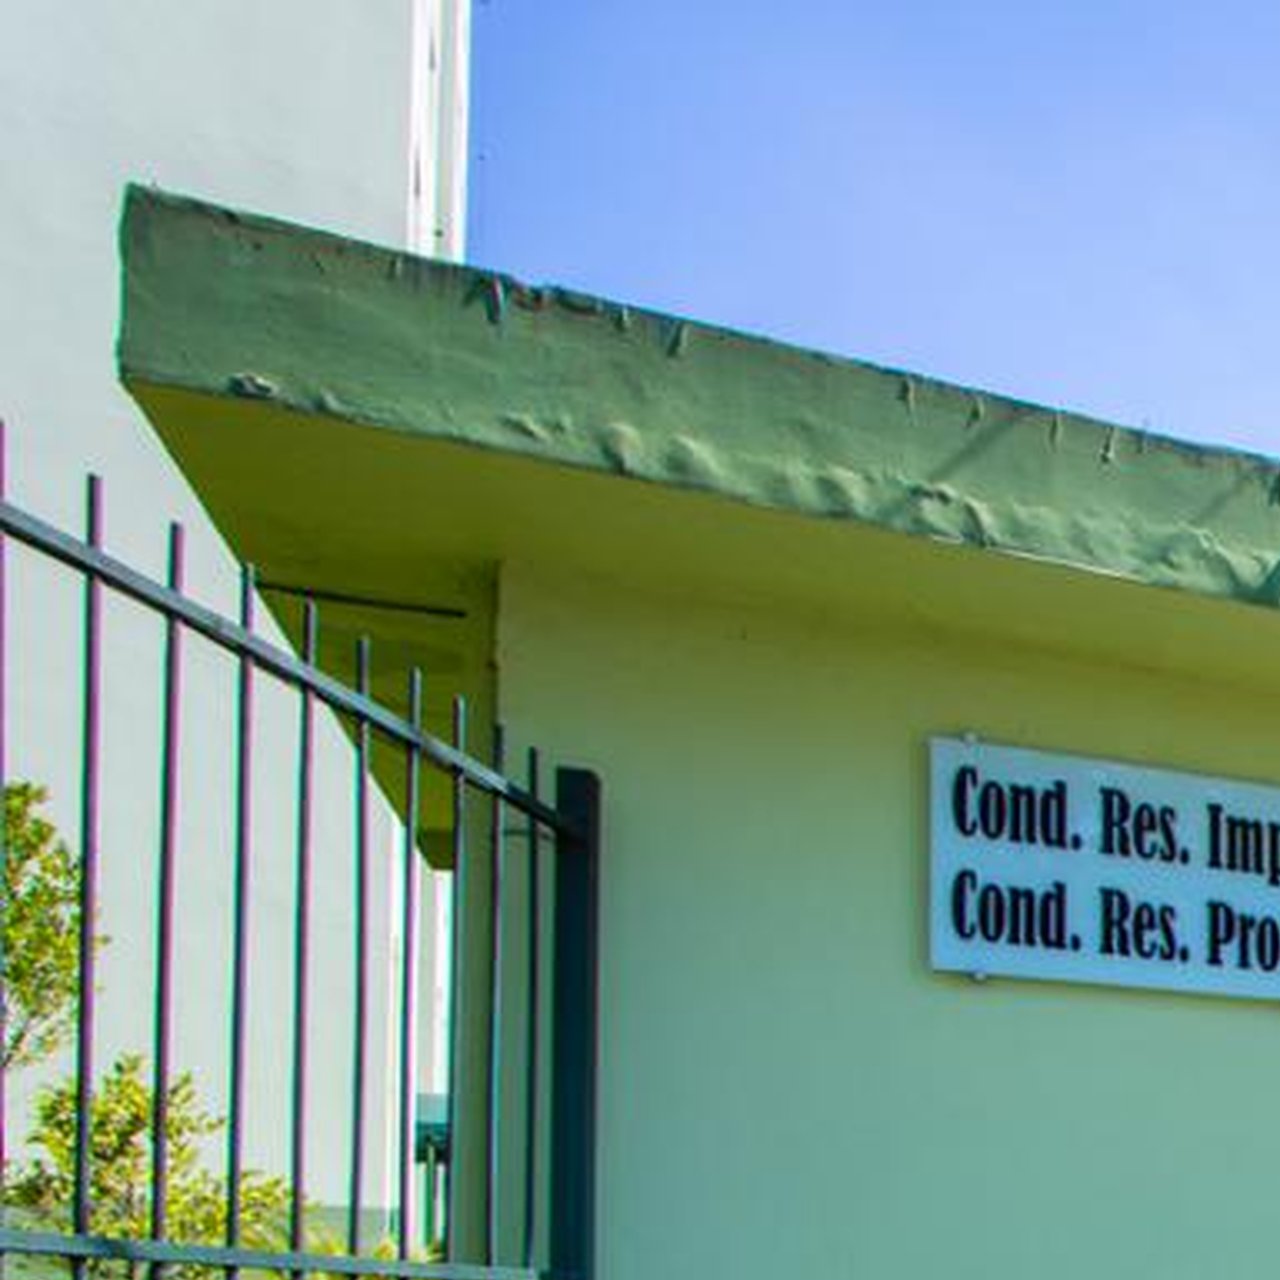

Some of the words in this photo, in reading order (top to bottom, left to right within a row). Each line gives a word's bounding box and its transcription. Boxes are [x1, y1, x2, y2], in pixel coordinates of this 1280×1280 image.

[952, 765, 1083, 850] Cond.
[1099, 785, 1190, 864] Res.
[951, 868, 1081, 951] Cond.
[1098, 886, 1190, 962] Res.
